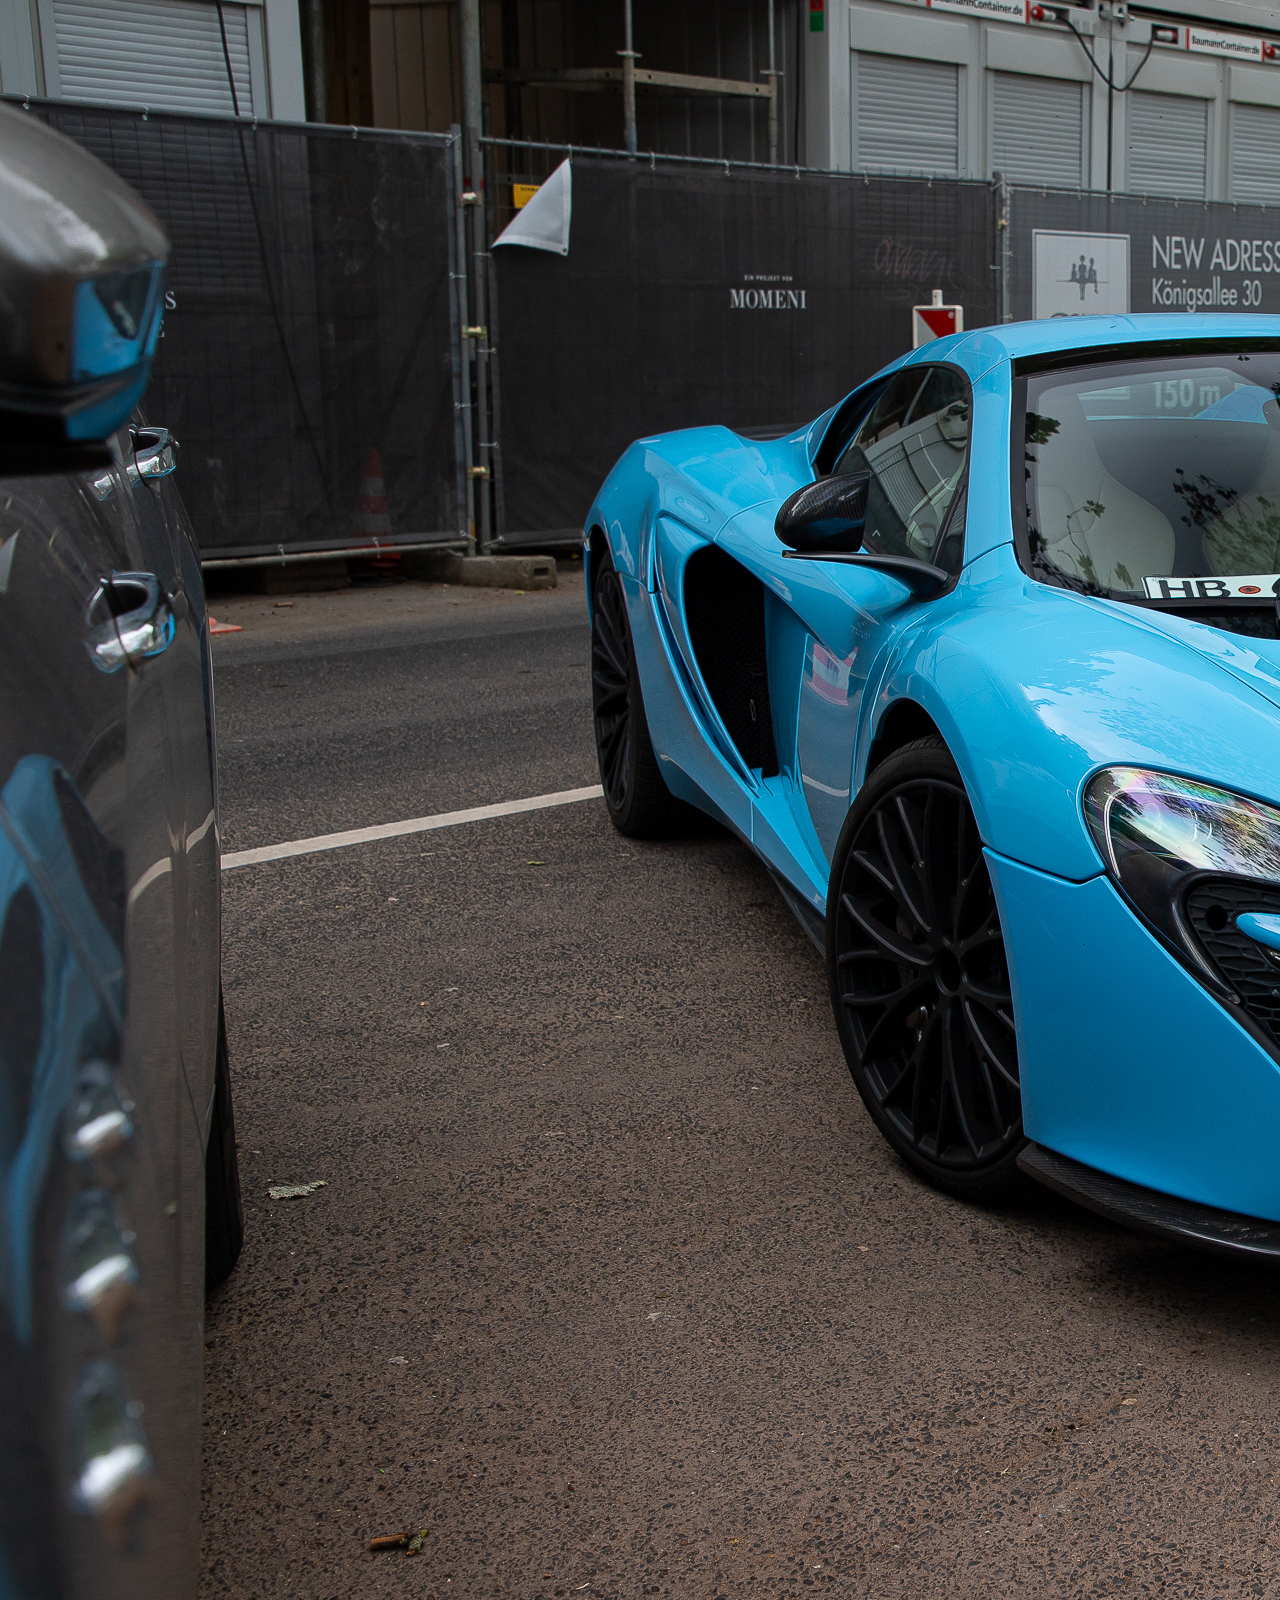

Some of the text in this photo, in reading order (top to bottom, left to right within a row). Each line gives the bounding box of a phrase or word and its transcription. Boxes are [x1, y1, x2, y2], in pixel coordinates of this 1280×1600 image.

[1152, 235, 1206, 270] NEW
[729, 288, 807, 309] MOMENI
[1152, 275, 1263, 313] Königsallee 30
[1153, 378, 1194, 410] 150
[1159, 579, 1232, 598] HB
